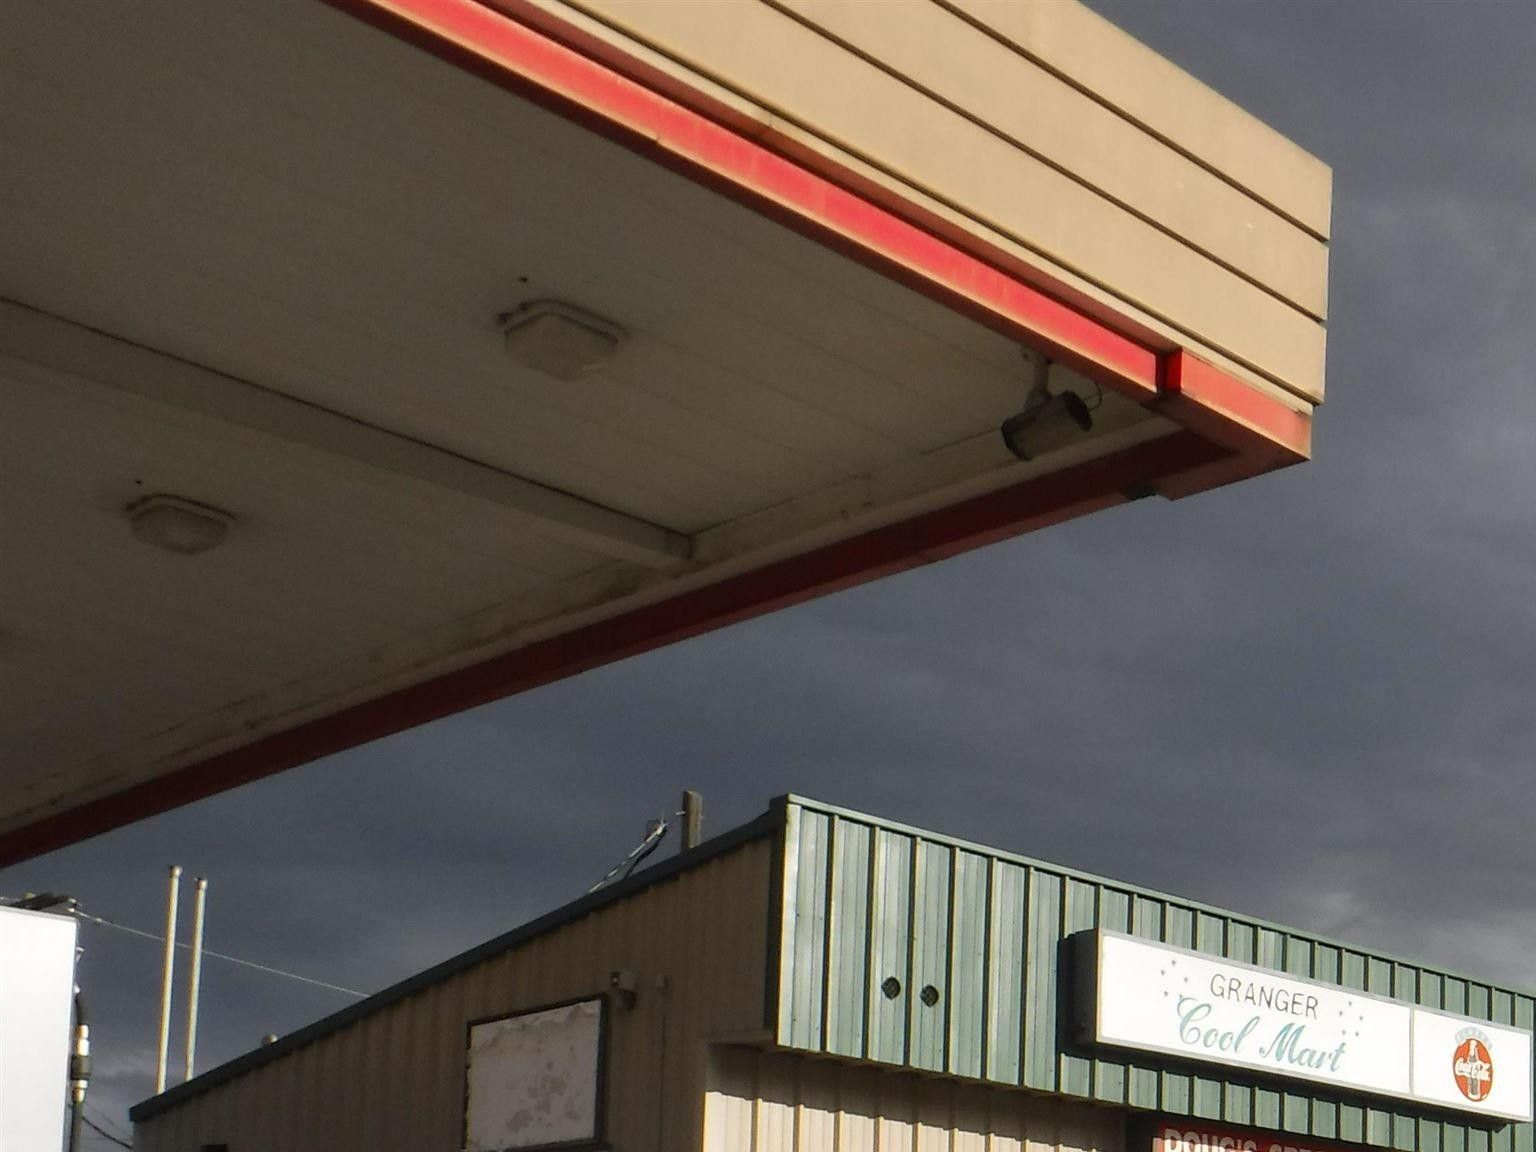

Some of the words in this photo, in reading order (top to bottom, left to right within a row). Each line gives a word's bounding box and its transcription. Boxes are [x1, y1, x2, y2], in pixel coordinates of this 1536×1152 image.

[1210, 973, 1319, 1020] GRANGER
[1177, 997, 1260, 1053] Cool
[1258, 1022, 1346, 1072] Mart
